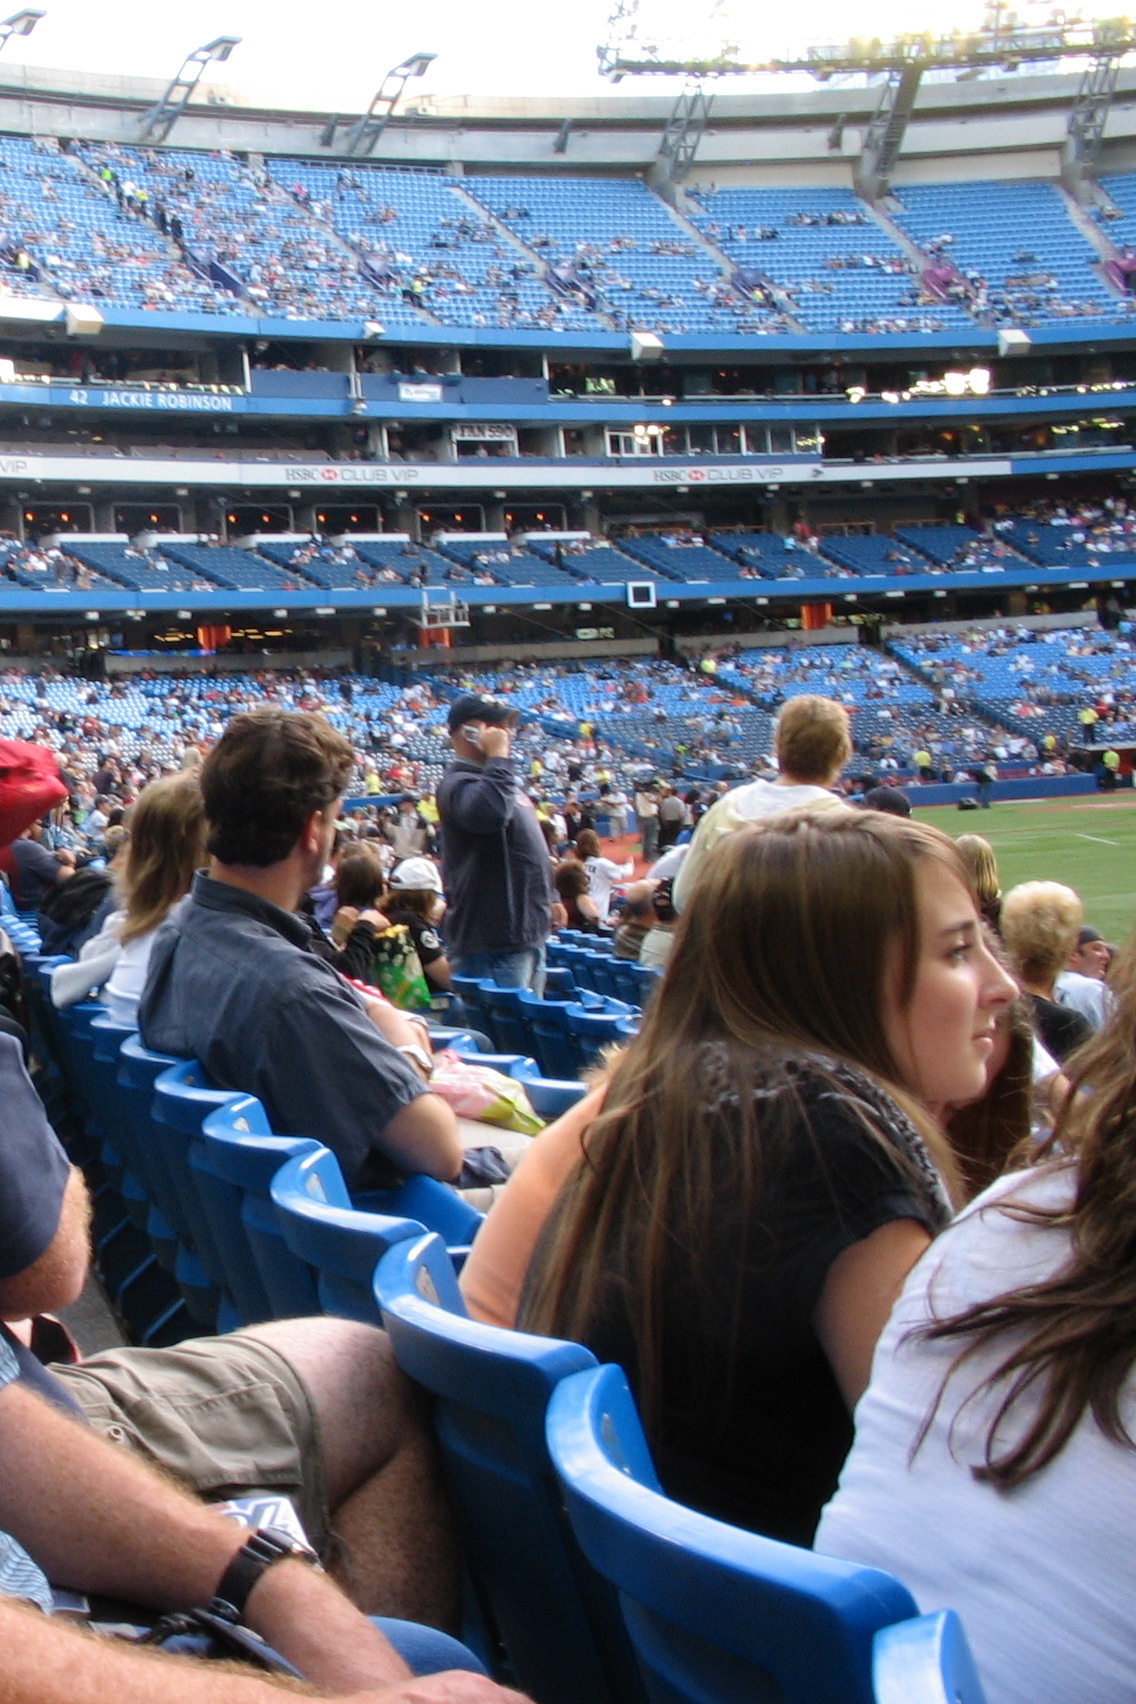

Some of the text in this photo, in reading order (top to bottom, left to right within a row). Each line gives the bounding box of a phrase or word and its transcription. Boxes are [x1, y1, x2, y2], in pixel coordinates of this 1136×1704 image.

[69, 390, 233, 411] 42 JACKIE ROBINSON
[285, 468, 419, 482] HSBC CLUB VIP
[653, 467, 784, 482] HSBC CLUB VIP
